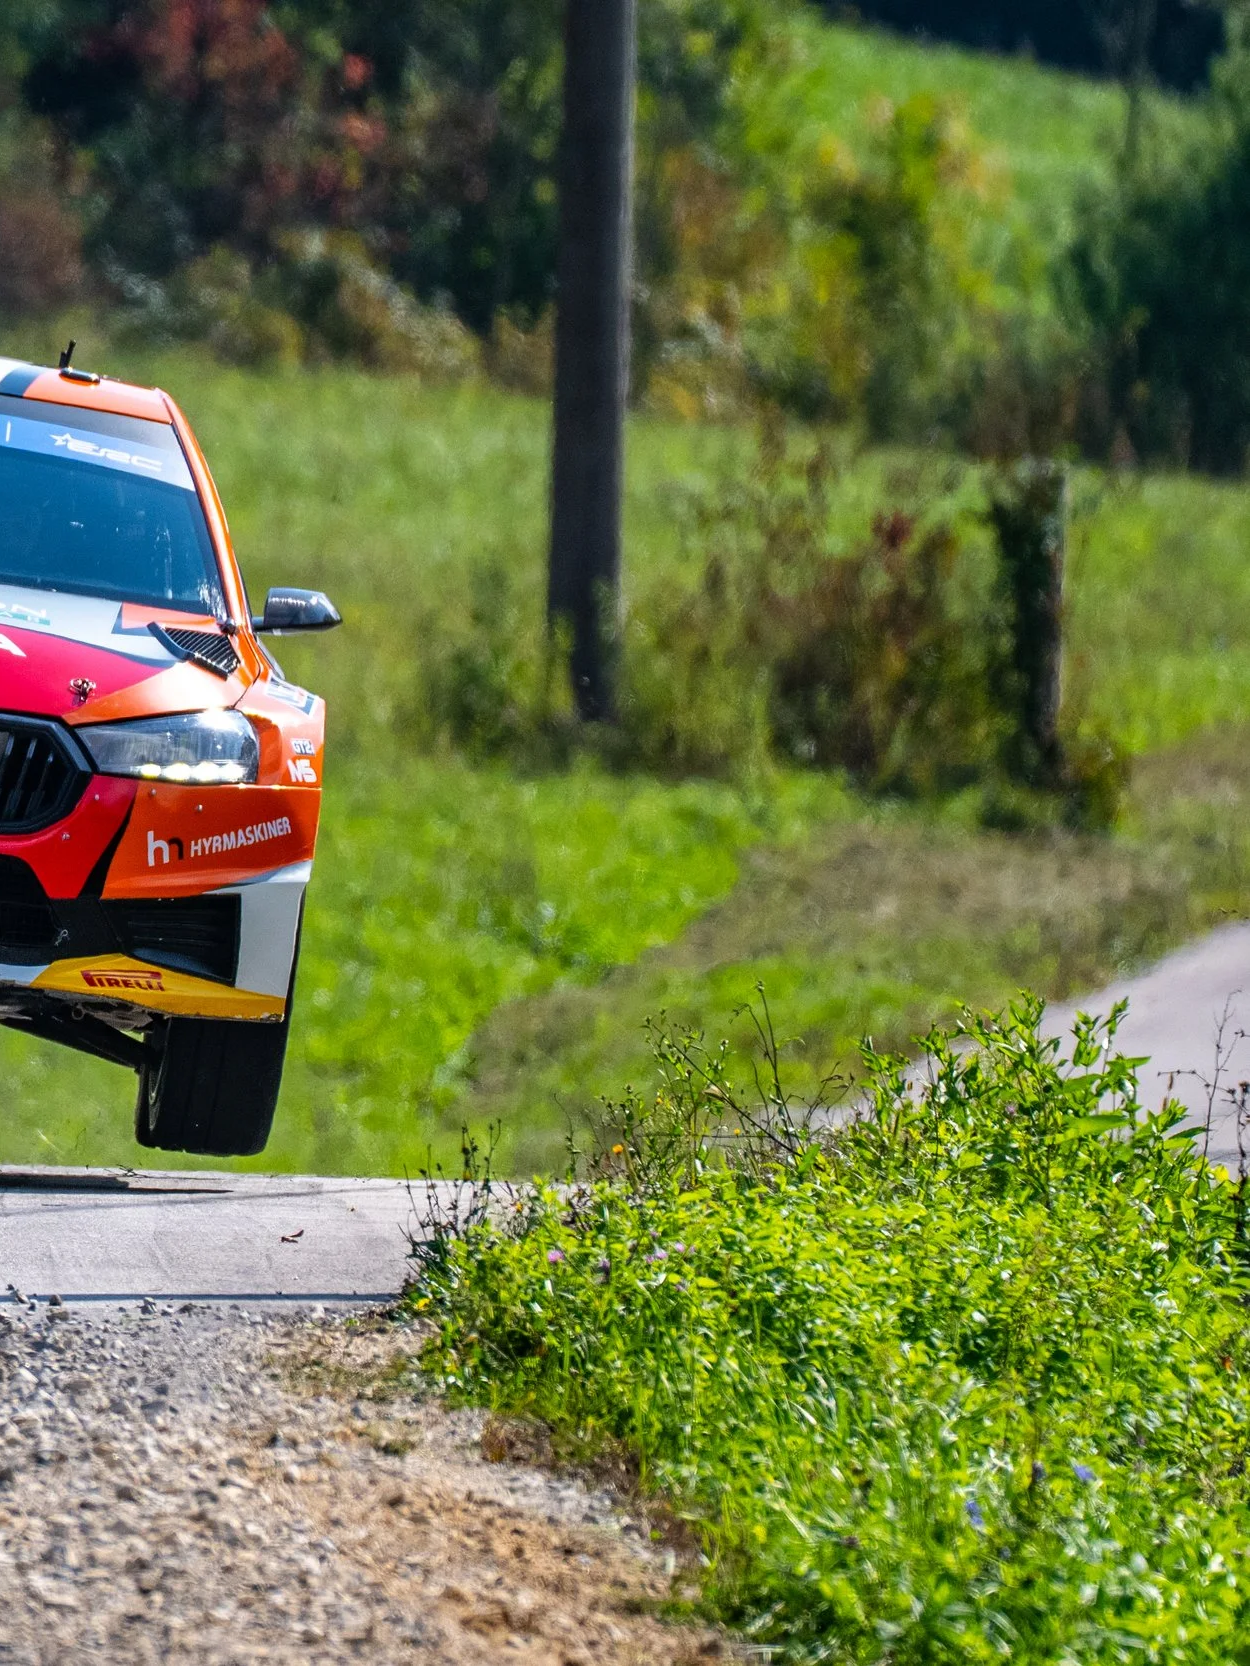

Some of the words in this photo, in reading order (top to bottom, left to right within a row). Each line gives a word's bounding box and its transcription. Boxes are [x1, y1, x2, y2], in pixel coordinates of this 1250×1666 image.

[66, 438, 163, 472] ERC
[190, 816, 292, 858] HYRMASKINER
[80, 969, 165, 992] PIRELLI
